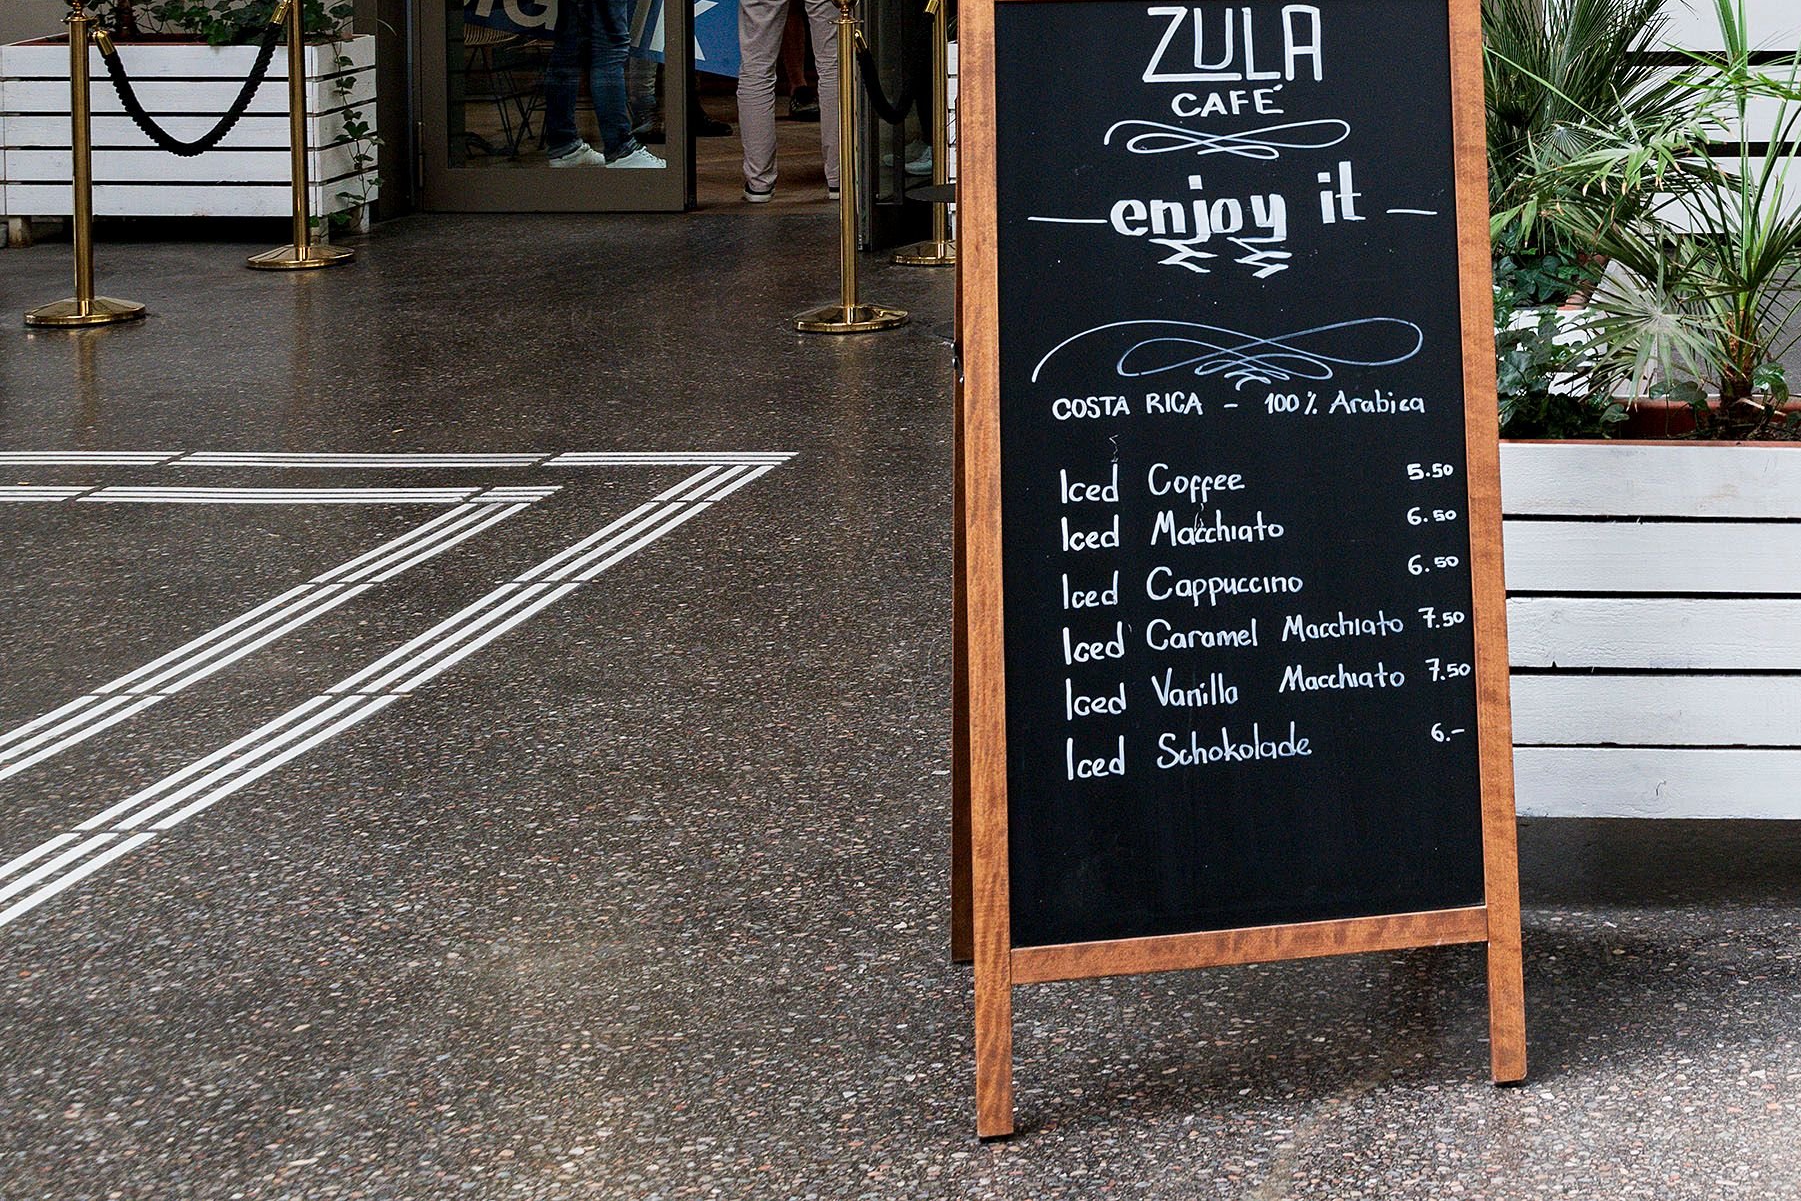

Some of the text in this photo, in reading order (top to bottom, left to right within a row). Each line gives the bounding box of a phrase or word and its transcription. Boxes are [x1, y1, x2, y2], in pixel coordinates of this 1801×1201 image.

[1142, 5, 1322, 82] ZULA
[1172, 84, 1284, 117] CAFÉ
[1110, 161, 1366, 278] enjoy it
[1052, 396, 1130, 420] COSTA
[1146, 391, 1203, 415] RICA
[1329, 389, 1425, 414] Arabica
[1060, 463, 1453, 503] Iced Coffee 5.50
[1061, 507, 1456, 551] Iced Macchiato 6.50
[1062, 555, 1459, 609] Iced Cappuccino 6.50
[1063, 607, 1464, 665] Iced Caramel Macchiato 7.50
[1066, 658, 1470, 720] Iced Vanilla Macchiato 7.50
[1067, 735, 1124, 780] Iced
[1157, 721, 1312, 768] Schokolade
